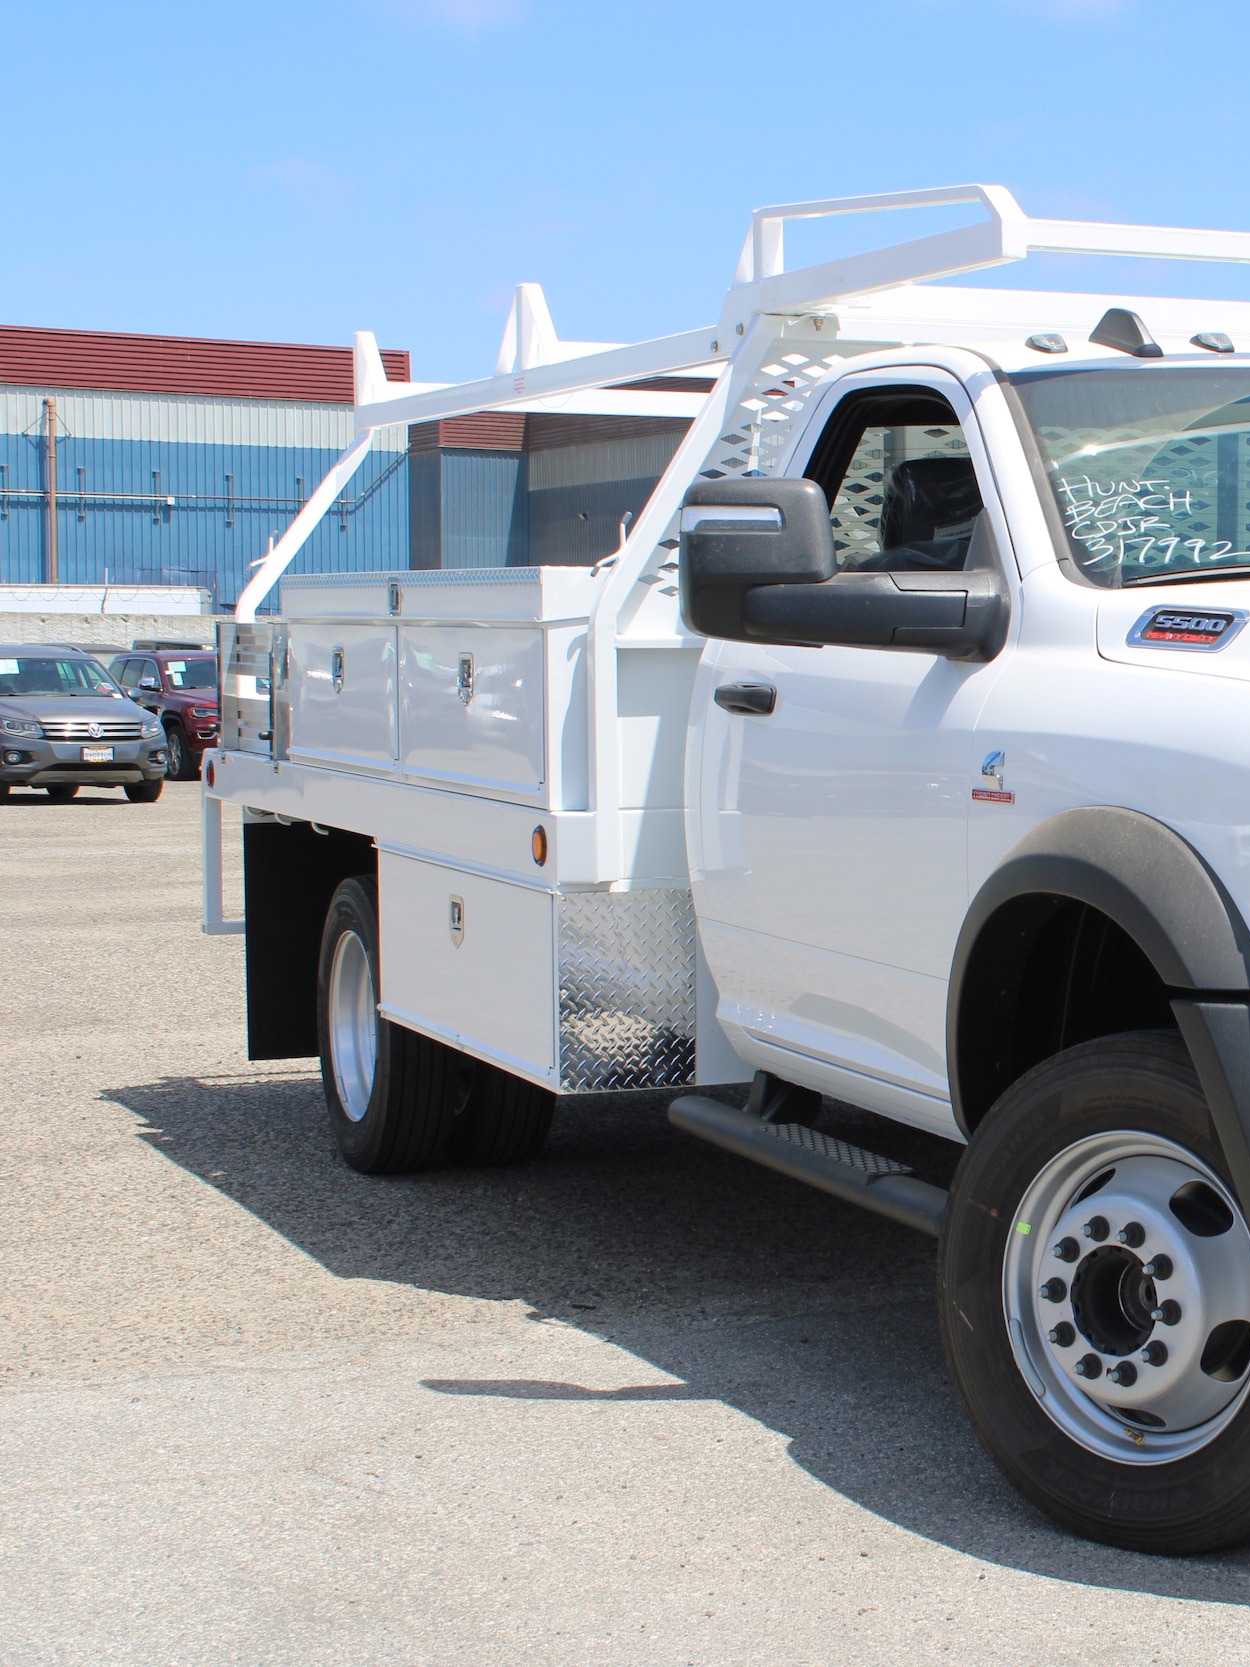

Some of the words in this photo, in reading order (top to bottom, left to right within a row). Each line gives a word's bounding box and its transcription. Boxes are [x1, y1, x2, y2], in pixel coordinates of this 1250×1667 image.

[1065, 491, 1192, 524] BEACH
[1071, 516, 1175, 539] CDJR
[1154, 615, 1227, 632] 5500
